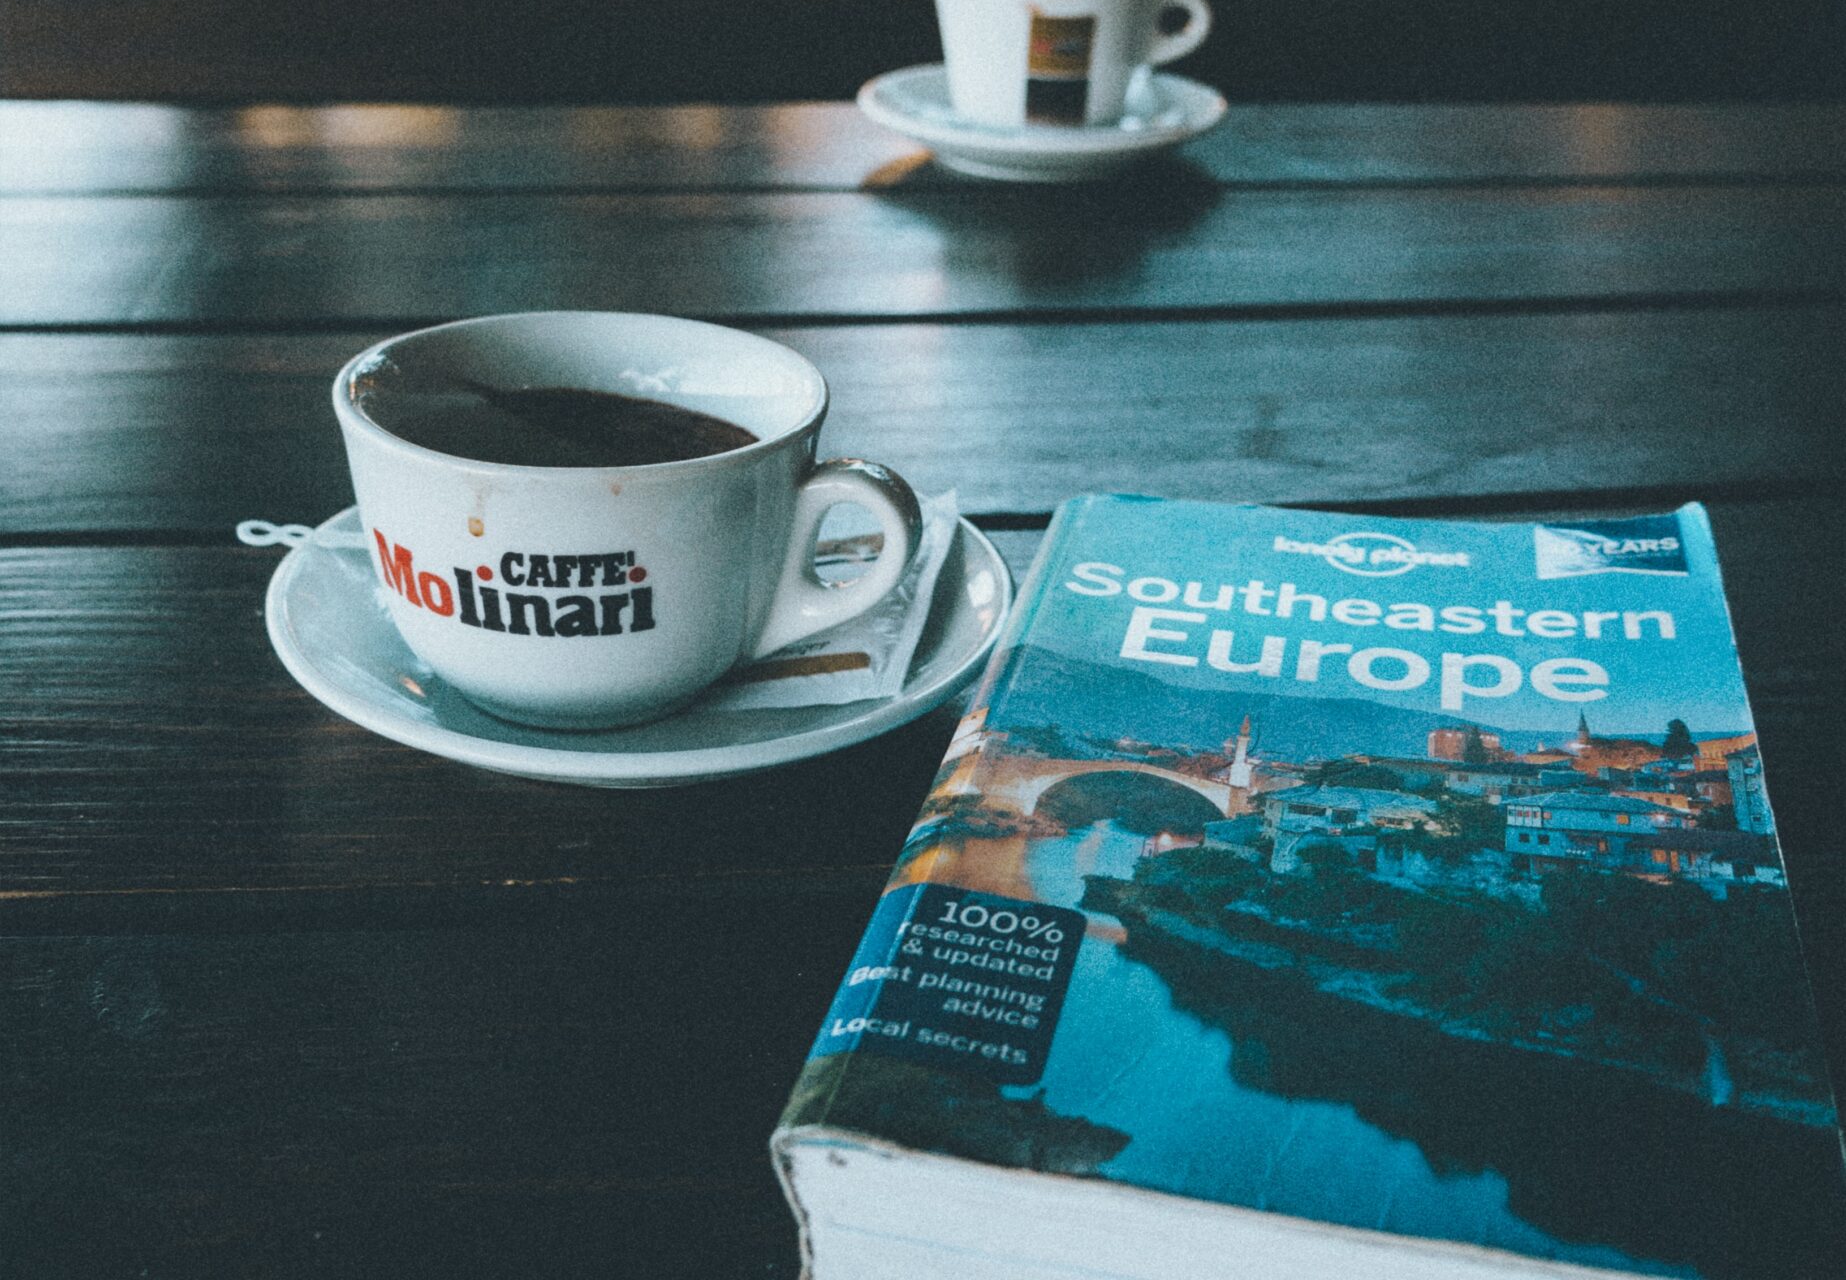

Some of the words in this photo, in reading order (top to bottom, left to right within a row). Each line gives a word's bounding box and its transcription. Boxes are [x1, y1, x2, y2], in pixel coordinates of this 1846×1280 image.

[1583, 536, 1680, 555] YEARS
[373, 527, 656, 638] Molinari
[1064, 562, 1678, 640] Southeastern
[1118, 606, 1611, 711] Europe
[897, 920, 1061, 962] researched
[937, 901, 1064, 943] 100%
[902, 938, 924, 956] &
[933, 945, 1056, 981] updated
[848, 965, 913, 986] Best
[918, 971, 1047, 1012] planning
[943, 997, 1041, 1029] advice
[831, 1017, 911, 1037] Local
[916, 1027, 1028, 1065] secrets
